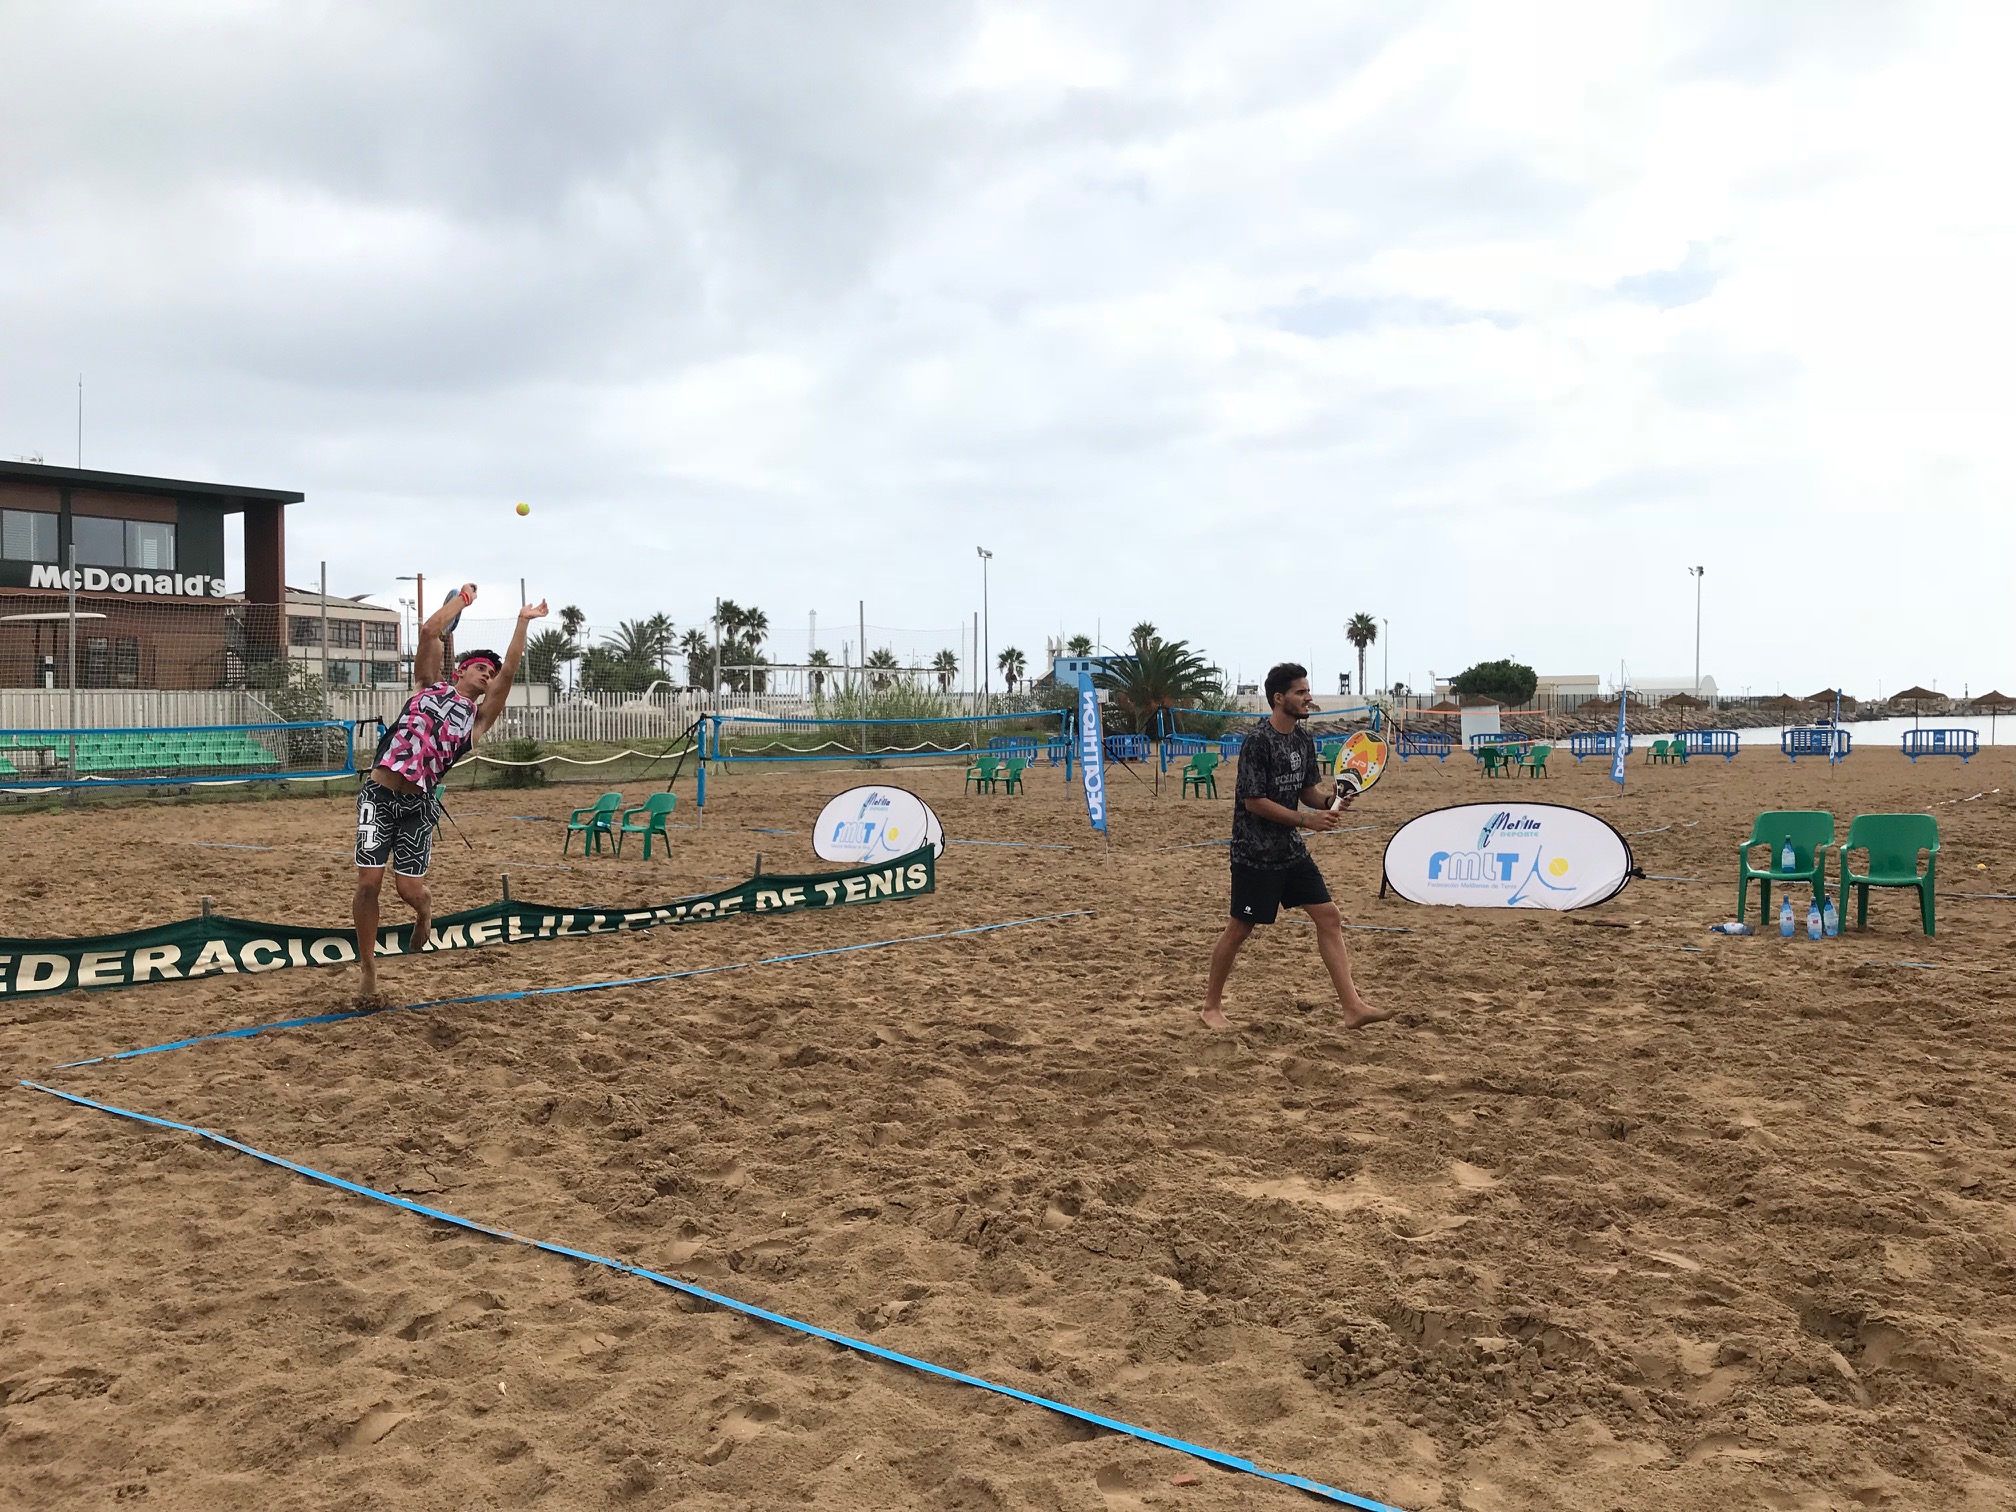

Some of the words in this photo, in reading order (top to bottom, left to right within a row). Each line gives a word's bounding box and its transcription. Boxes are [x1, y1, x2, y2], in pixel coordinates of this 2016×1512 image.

[29, 565, 226, 598] McDonald's
[0, 932, 403, 992] DERACION
[814, 863, 928, 906] TENIS
